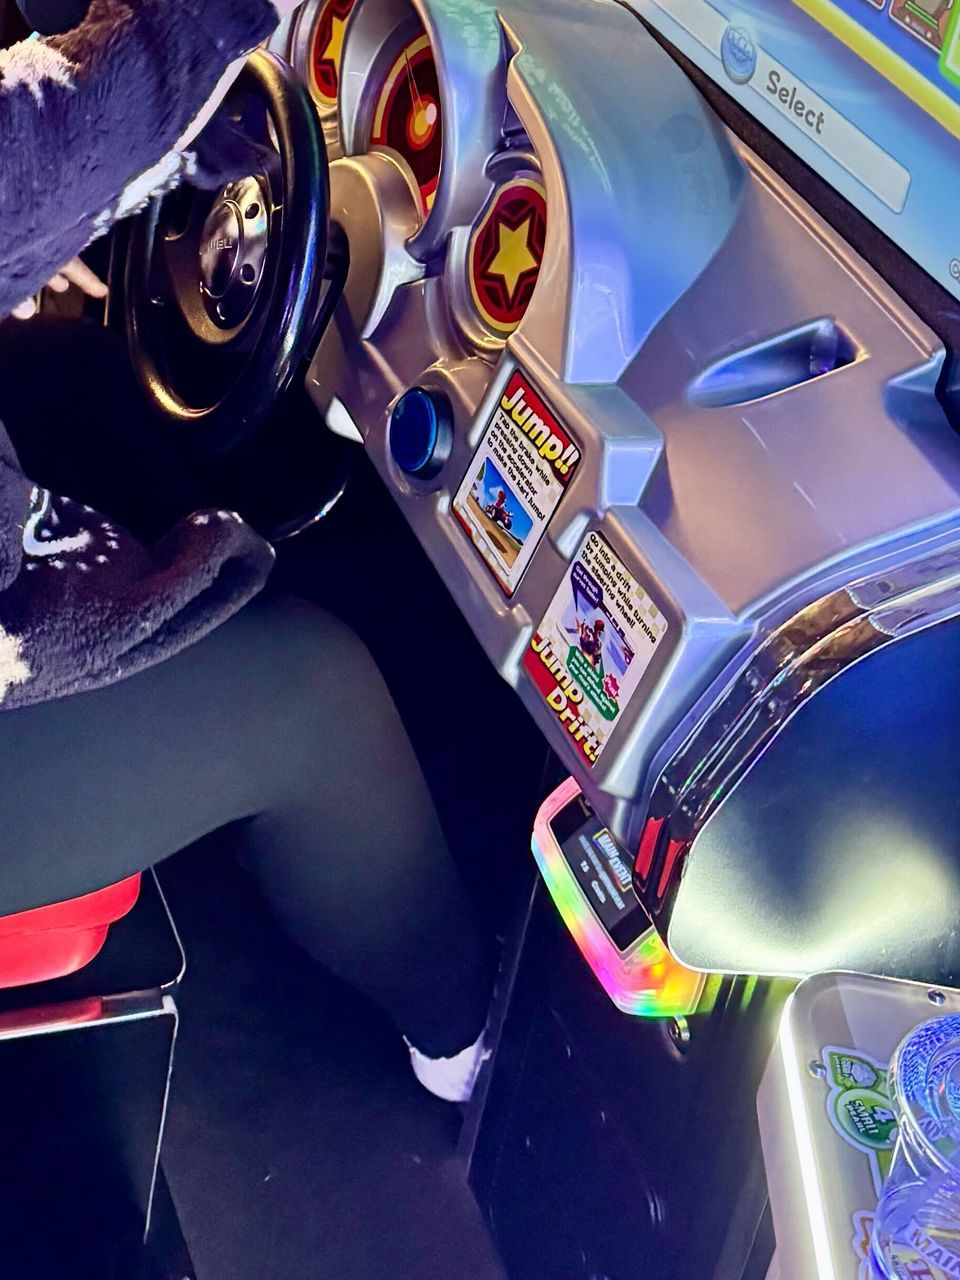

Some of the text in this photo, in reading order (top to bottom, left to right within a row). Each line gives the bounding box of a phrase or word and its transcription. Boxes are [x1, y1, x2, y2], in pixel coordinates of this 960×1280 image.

[766, 70, 825, 135] Select
[491, 430, 538, 496] on the accelerator
[494, 422, 533, 477] pressing down
[498, 411, 550, 487] Tap the brake while
[500, 387, 580, 475] Jump!!
[493, 447, 507, 469] make
[507, 467, 517, 482] the
[516, 480, 529, 499] kart
[528, 496, 546, 523] jump!
[581, 550, 637, 629] the steering wheel!
[585, 541, 657, 644] by jumping while turning
[590, 534, 598, 547] Go
[599, 546, 611, 564] into
[616, 571, 631, 592] drift
[531, 639, 584, 703] Jump
[598, 833, 619, 859] MAIN
[609, 857, 632, 885] EVENT
[846, 1104, 866, 1134] PEARL
[873, 1106, 895, 1123] 4
